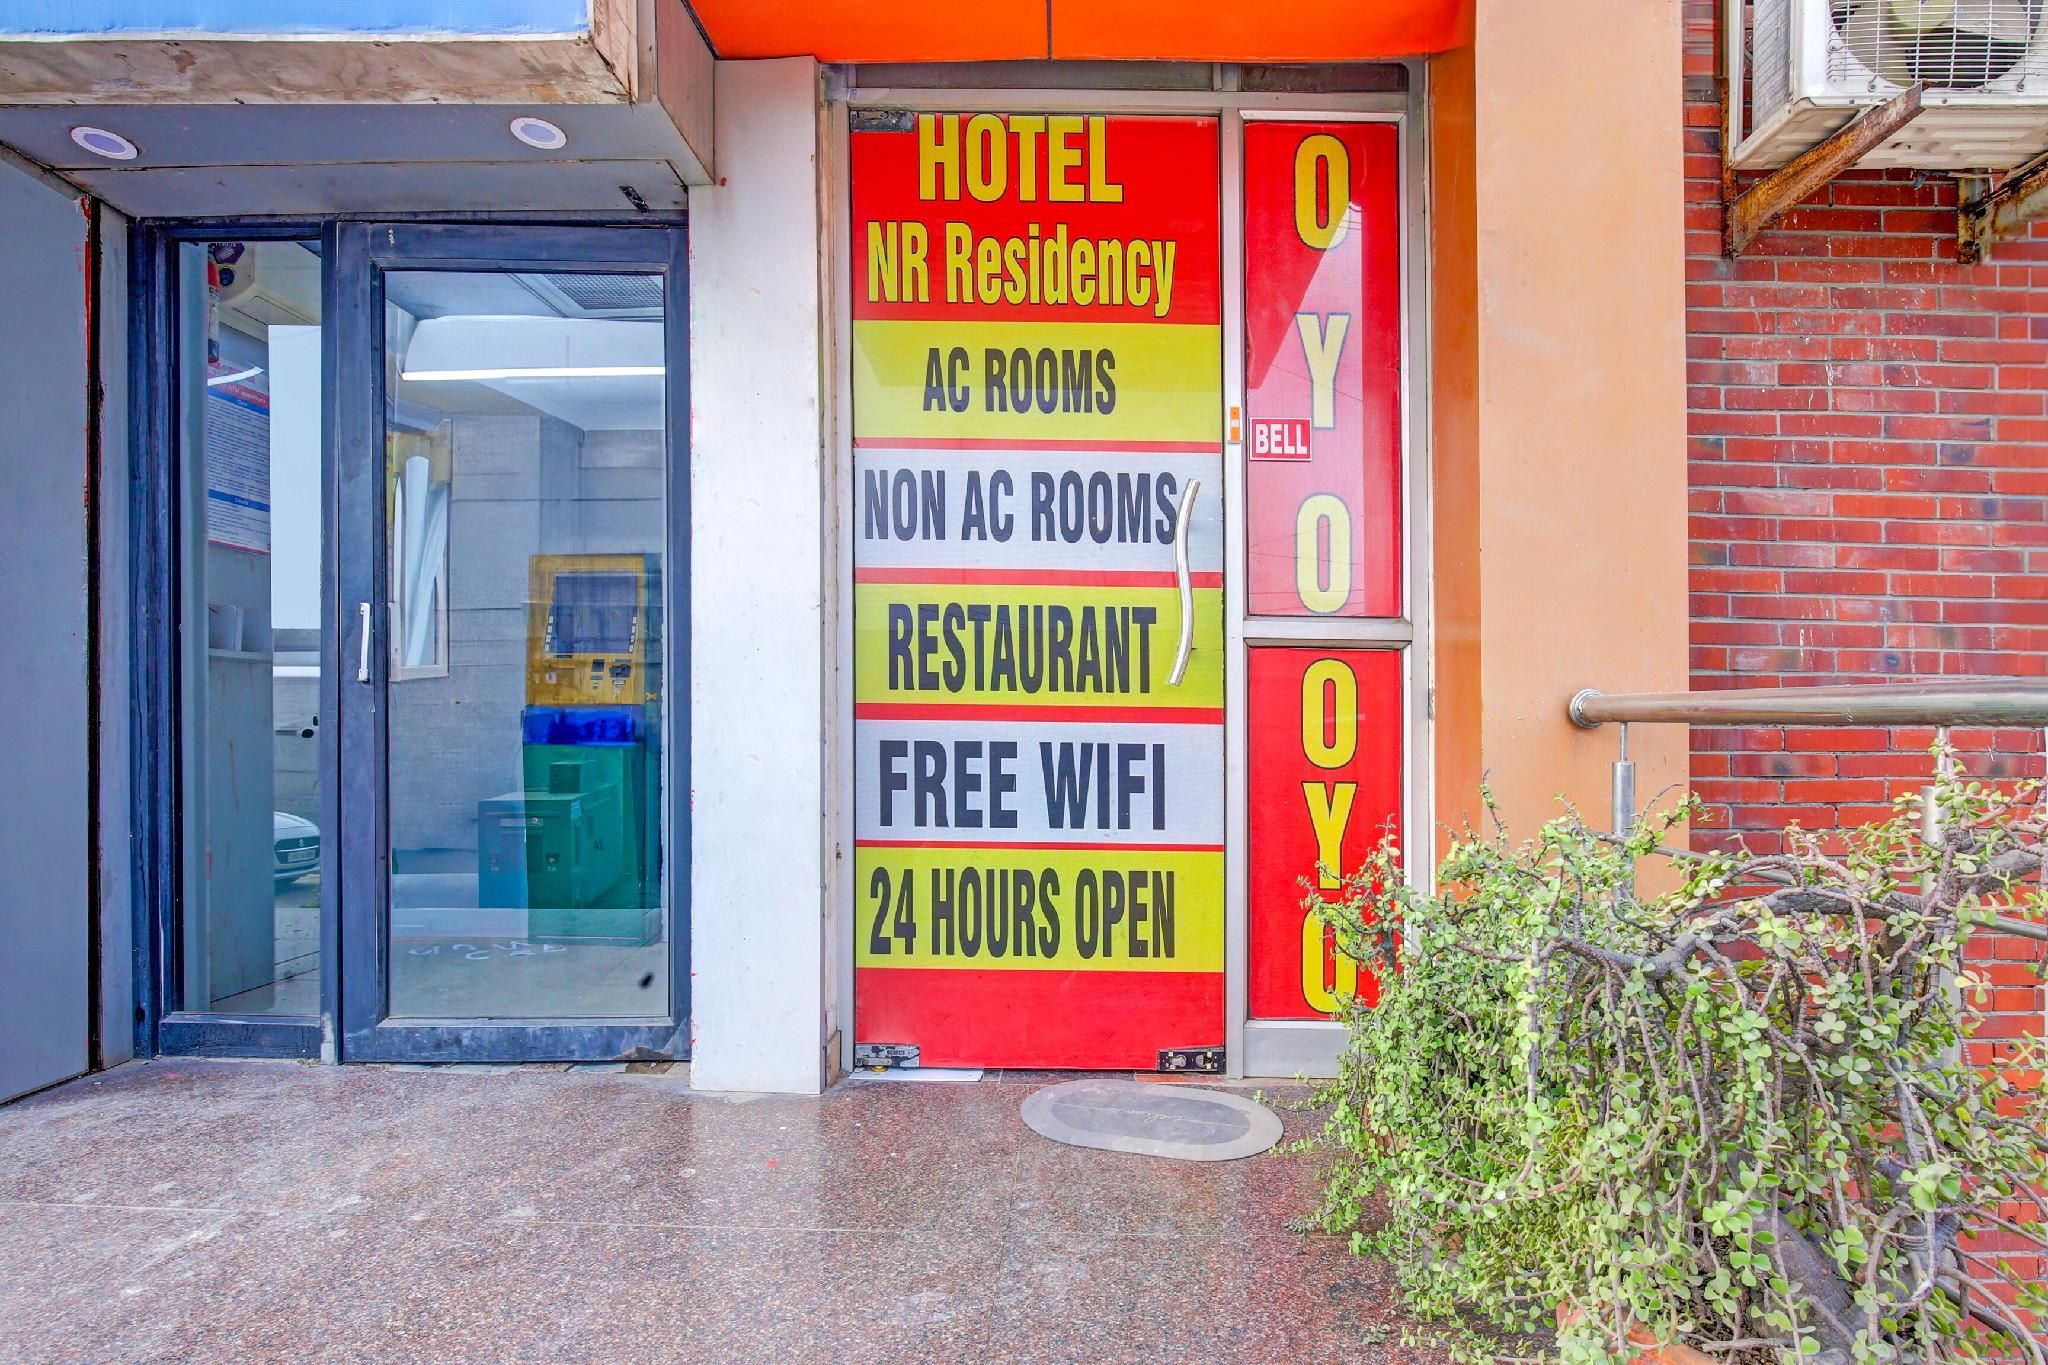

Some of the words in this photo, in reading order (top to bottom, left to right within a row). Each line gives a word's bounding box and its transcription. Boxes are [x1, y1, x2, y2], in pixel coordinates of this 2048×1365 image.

[918, 113, 1124, 203] HOTEL
[867, 220, 930, 303] NR
[945, 221, 1177, 318] Residency
[923, 347, 970, 412] AC
[985, 347, 1116, 415] ROOMS
[1293, 133, 1352, 614] OYO
[1255, 424, 1308, 455] BELL
[864, 468, 946, 541] NON
[961, 469, 1014, 543] AC
[1031, 470, 1178, 545] ROOMS
[888, 602, 1157, 693] RESTAURANT
[879, 740, 1018, 829] FREE
[1039, 742, 1166, 830] WIFI
[869, 866, 916, 955] 24
[931, 866, 1061, 959] HOURS
[1075, 868, 1175, 959] OPEN
